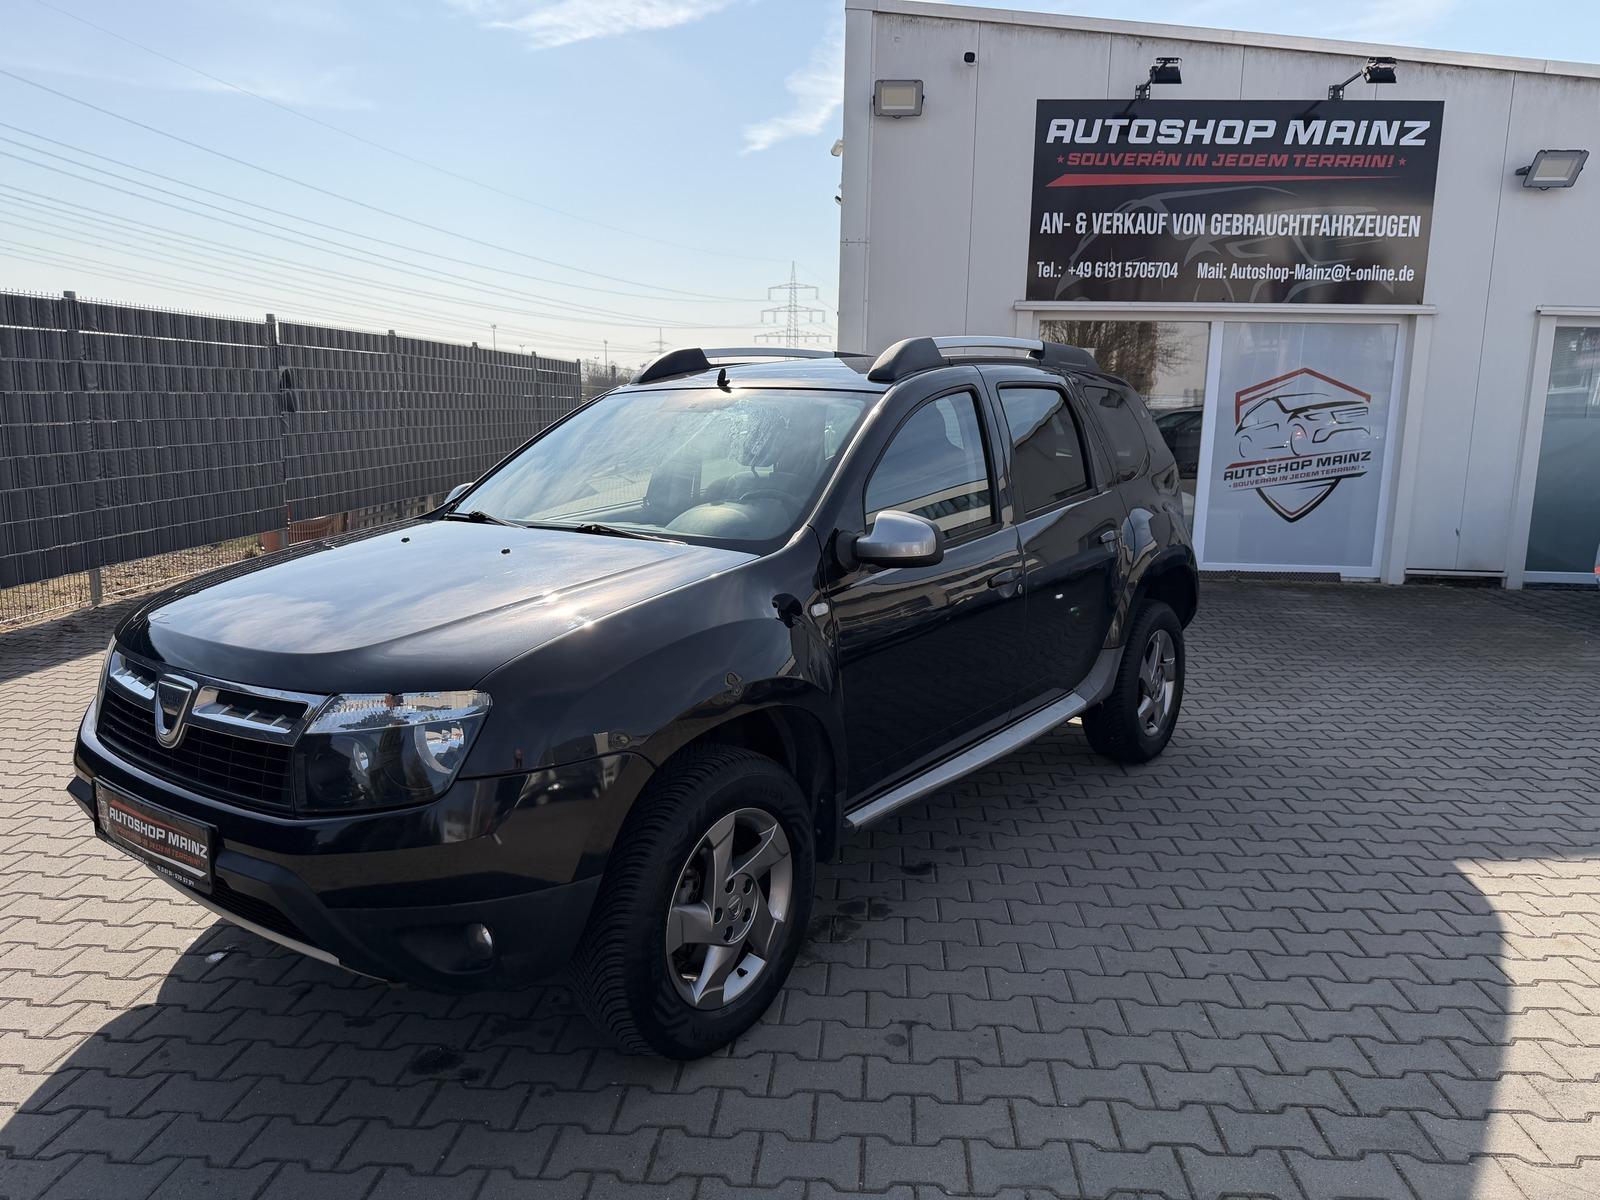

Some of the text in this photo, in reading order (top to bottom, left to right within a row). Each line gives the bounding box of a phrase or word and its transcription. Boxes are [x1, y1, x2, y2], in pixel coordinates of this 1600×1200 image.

[1046, 118, 1431, 146] AUTOSHOP MAINZ
[1067, 150, 1395, 168] SOUVERÄN IN JEDEM TERRAIN!
[1040, 212, 1421, 238] AN- & VERKAUF VON GEBRAUCHTFAHRZEUGEN
[1037, 261, 1178, 279] Tel.: +49 6131 5705704
[1197, 262, 1414, 282] Mail: Autoshop-Mainz@t-online.de
[1224, 450, 1372, 481] AUTOSHOP MAINZ
[109, 807, 165, 840] AUTOSHOP
[168, 831, 208, 859] MAINZ
